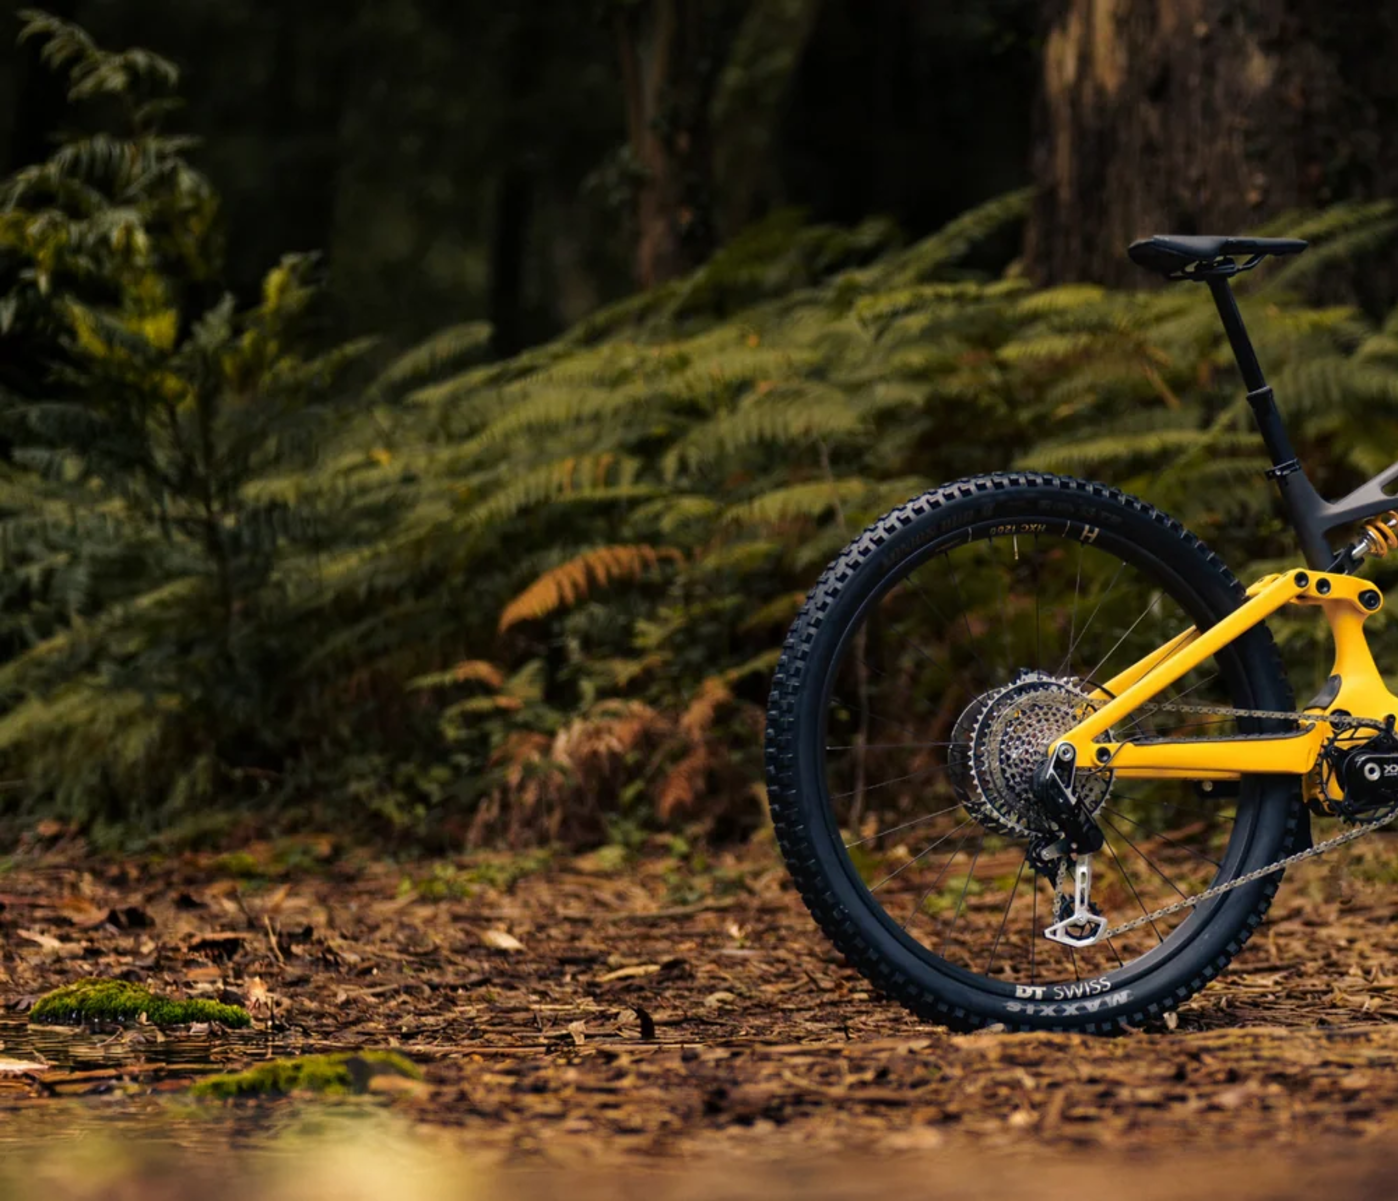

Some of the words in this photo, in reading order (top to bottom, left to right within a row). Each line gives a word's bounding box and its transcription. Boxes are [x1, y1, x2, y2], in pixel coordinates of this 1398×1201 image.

[1015, 984, 1046, 1000] DT
[1053, 976, 1111, 1000] SWISS
[1003, 989, 1135, 1017] MAXXIS
